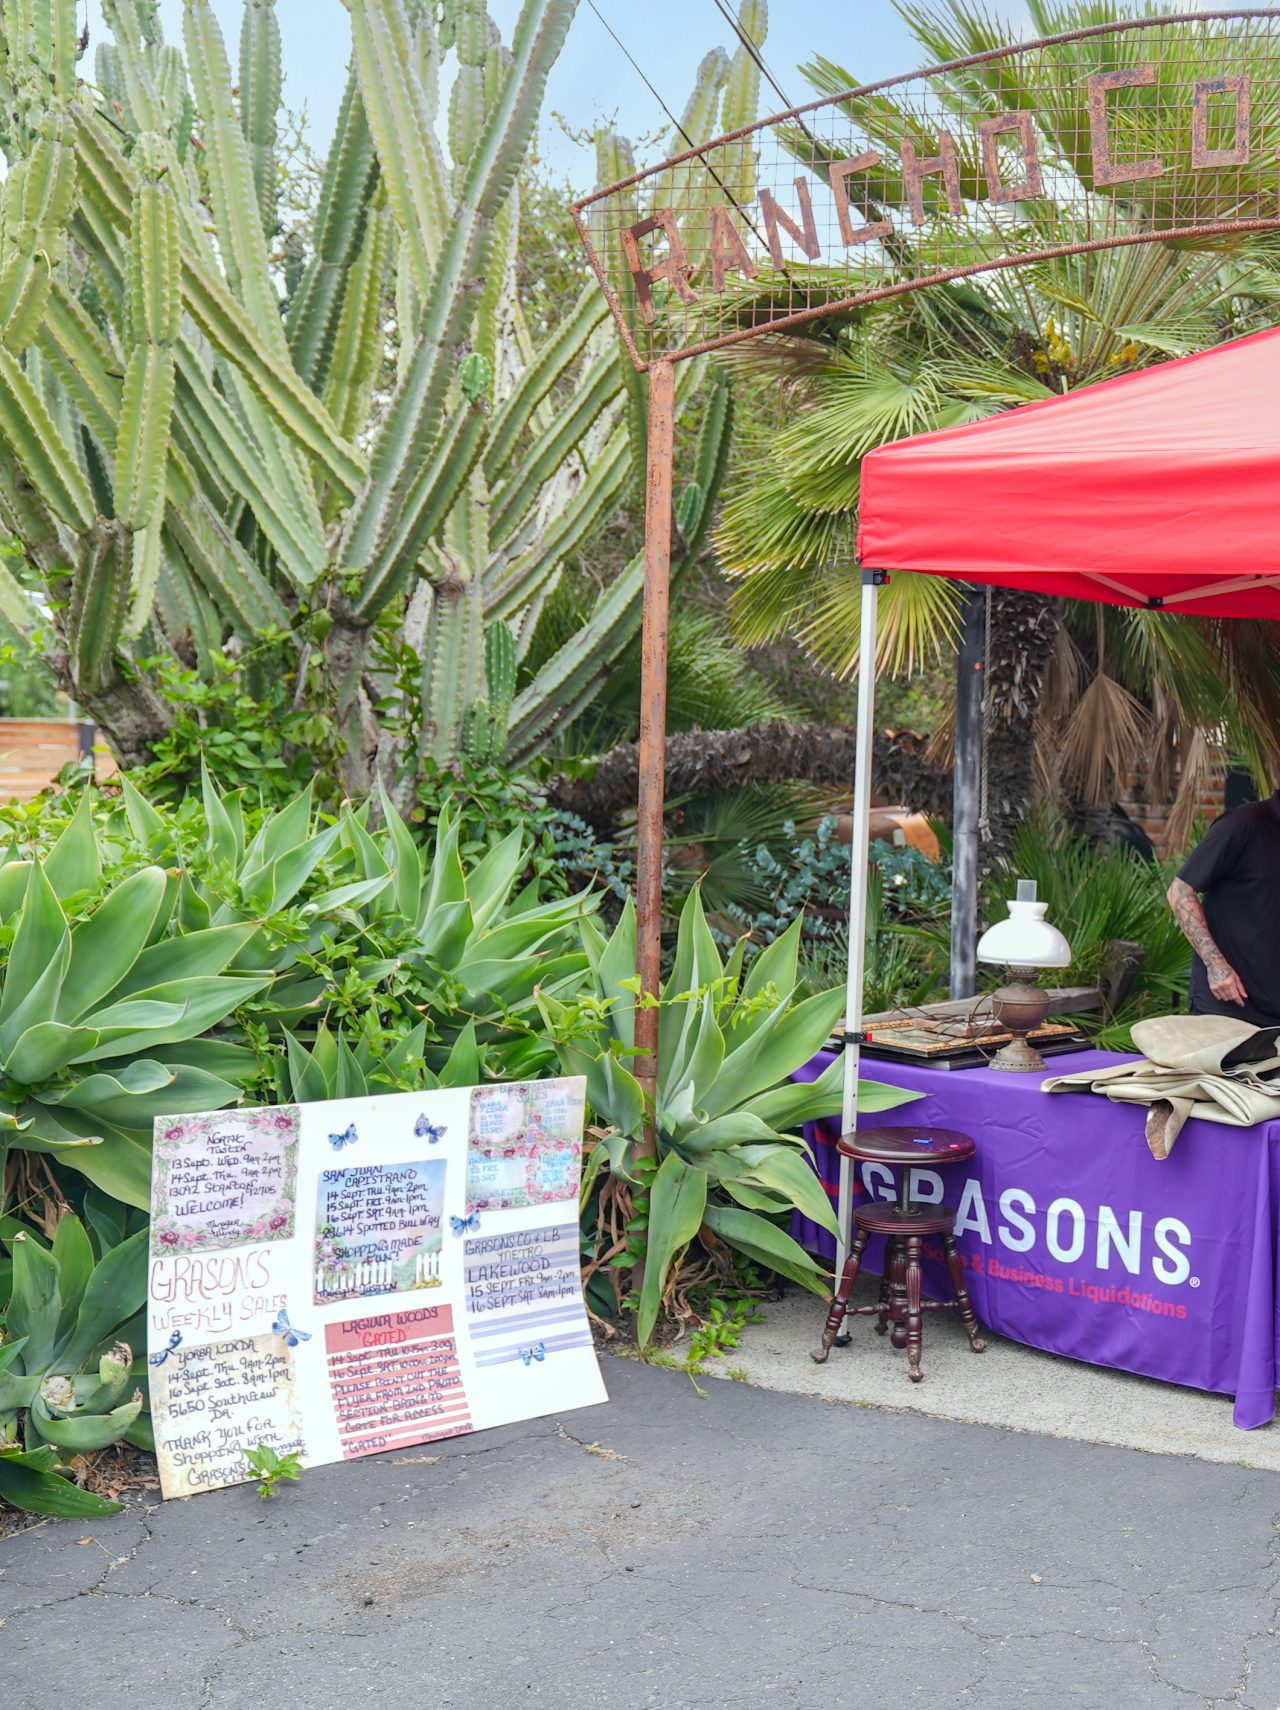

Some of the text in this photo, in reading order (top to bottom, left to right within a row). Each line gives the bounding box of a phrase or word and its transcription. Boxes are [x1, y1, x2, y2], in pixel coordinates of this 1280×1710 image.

[620, 109, 1041, 325] RANCHO
[345, 1168, 417, 1188] CAPISTRANO
[332, 1235, 424, 1260] SHOPPING MADE
[465, 1234, 514, 1255] GRASONS
[497, 1245, 543, 1262] METRO
[151, 1250, 270, 1303] GRASONS
[468, 1257, 551, 1283] LAKEWOOD
[470, 1285, 484, 1298] 15
[988, 1260, 1064, 1293] Business
[1068, 1278, 1188, 1320] Liquidations
[153, 1294, 287, 1333] WEEKLY SALES
[471, 1301, 485, 1313] 16
[342, 1306, 439, 1335] LAGUNA WOODS
[334, 1381, 374, 1397] PLEASE
[168, 1400, 205, 1418] 5650
[163, 1430, 211, 1452] THANK
